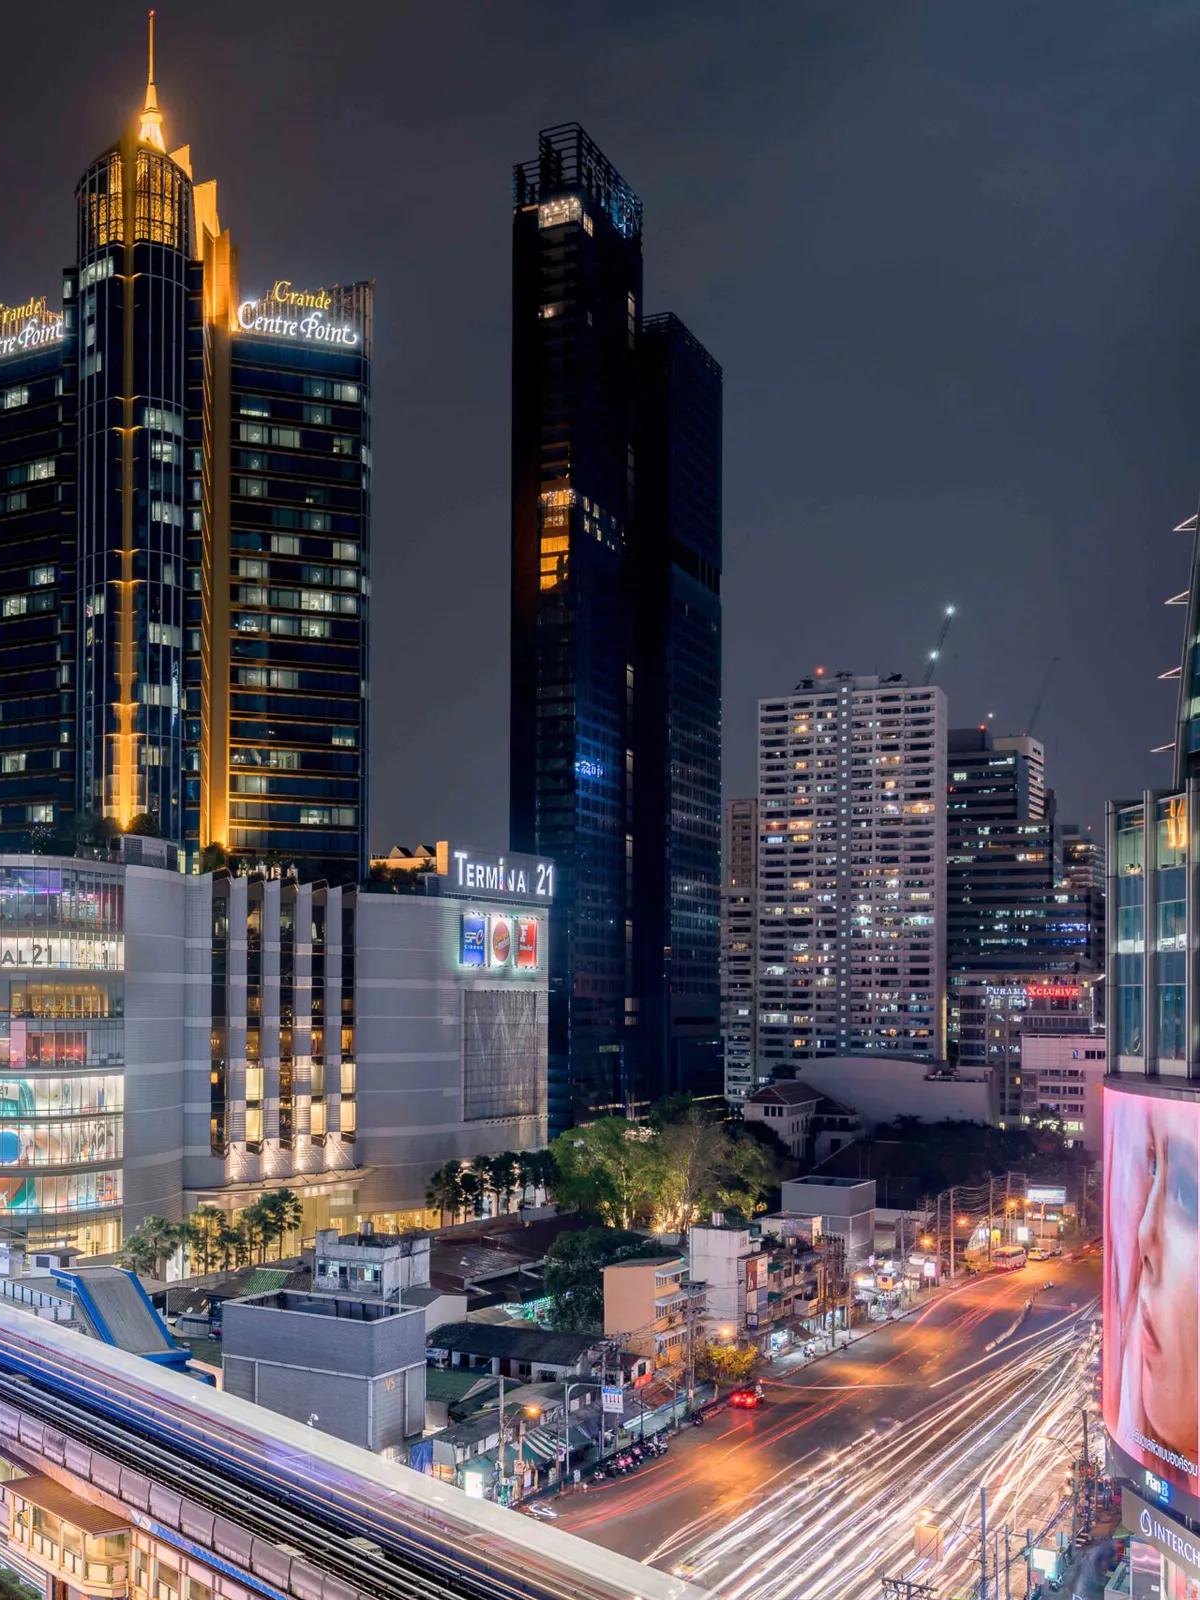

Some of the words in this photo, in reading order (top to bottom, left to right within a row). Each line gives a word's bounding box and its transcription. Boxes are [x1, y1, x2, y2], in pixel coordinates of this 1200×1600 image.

[275, 281, 331, 310] Grande
[18, 319, 63, 348] Point
[238, 301, 297, 336] Centre
[300, 312, 357, 344] Point
[537, 863, 553, 896] 21
[31, 944, 53, 965] 21
